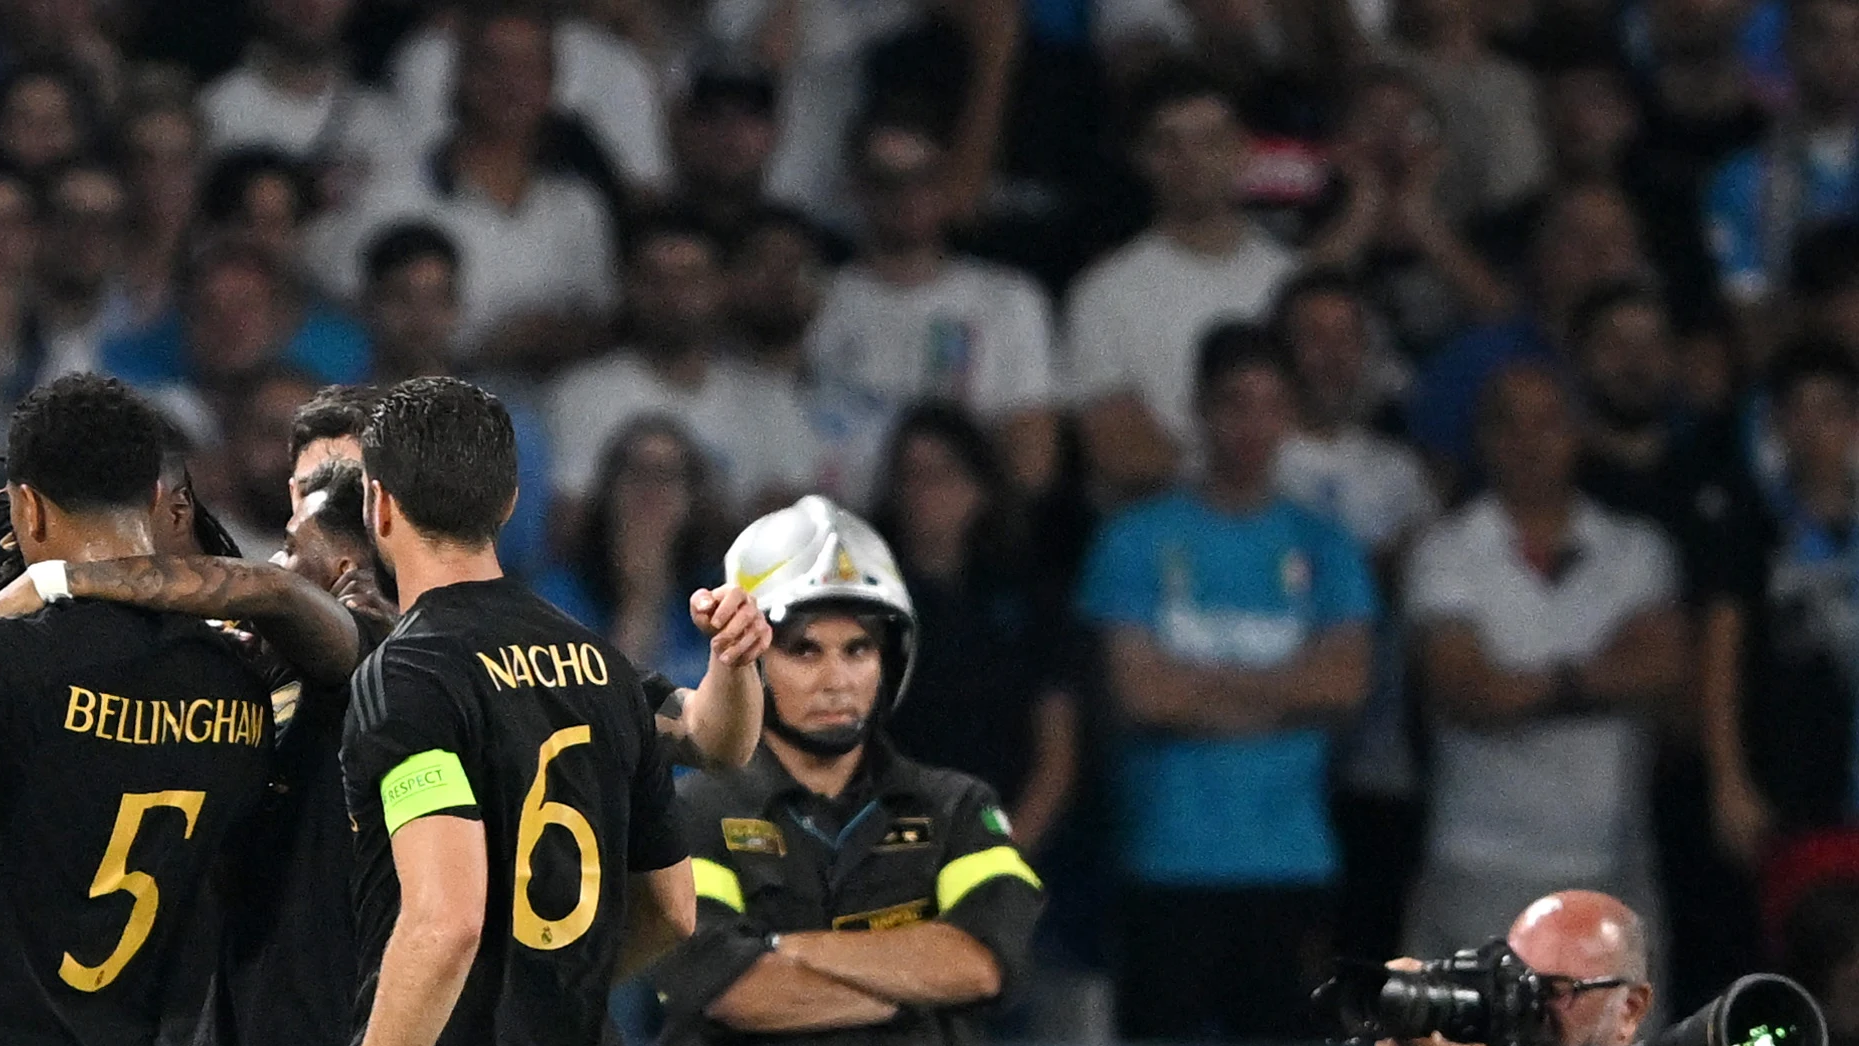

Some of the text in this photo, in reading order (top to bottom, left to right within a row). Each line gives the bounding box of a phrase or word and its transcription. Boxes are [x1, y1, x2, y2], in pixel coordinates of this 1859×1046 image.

[475, 642, 608, 692] NACHO
[388, 769, 443, 802] RESPECT
[512, 724, 602, 951] 6
[57, 790, 206, 993] 5
